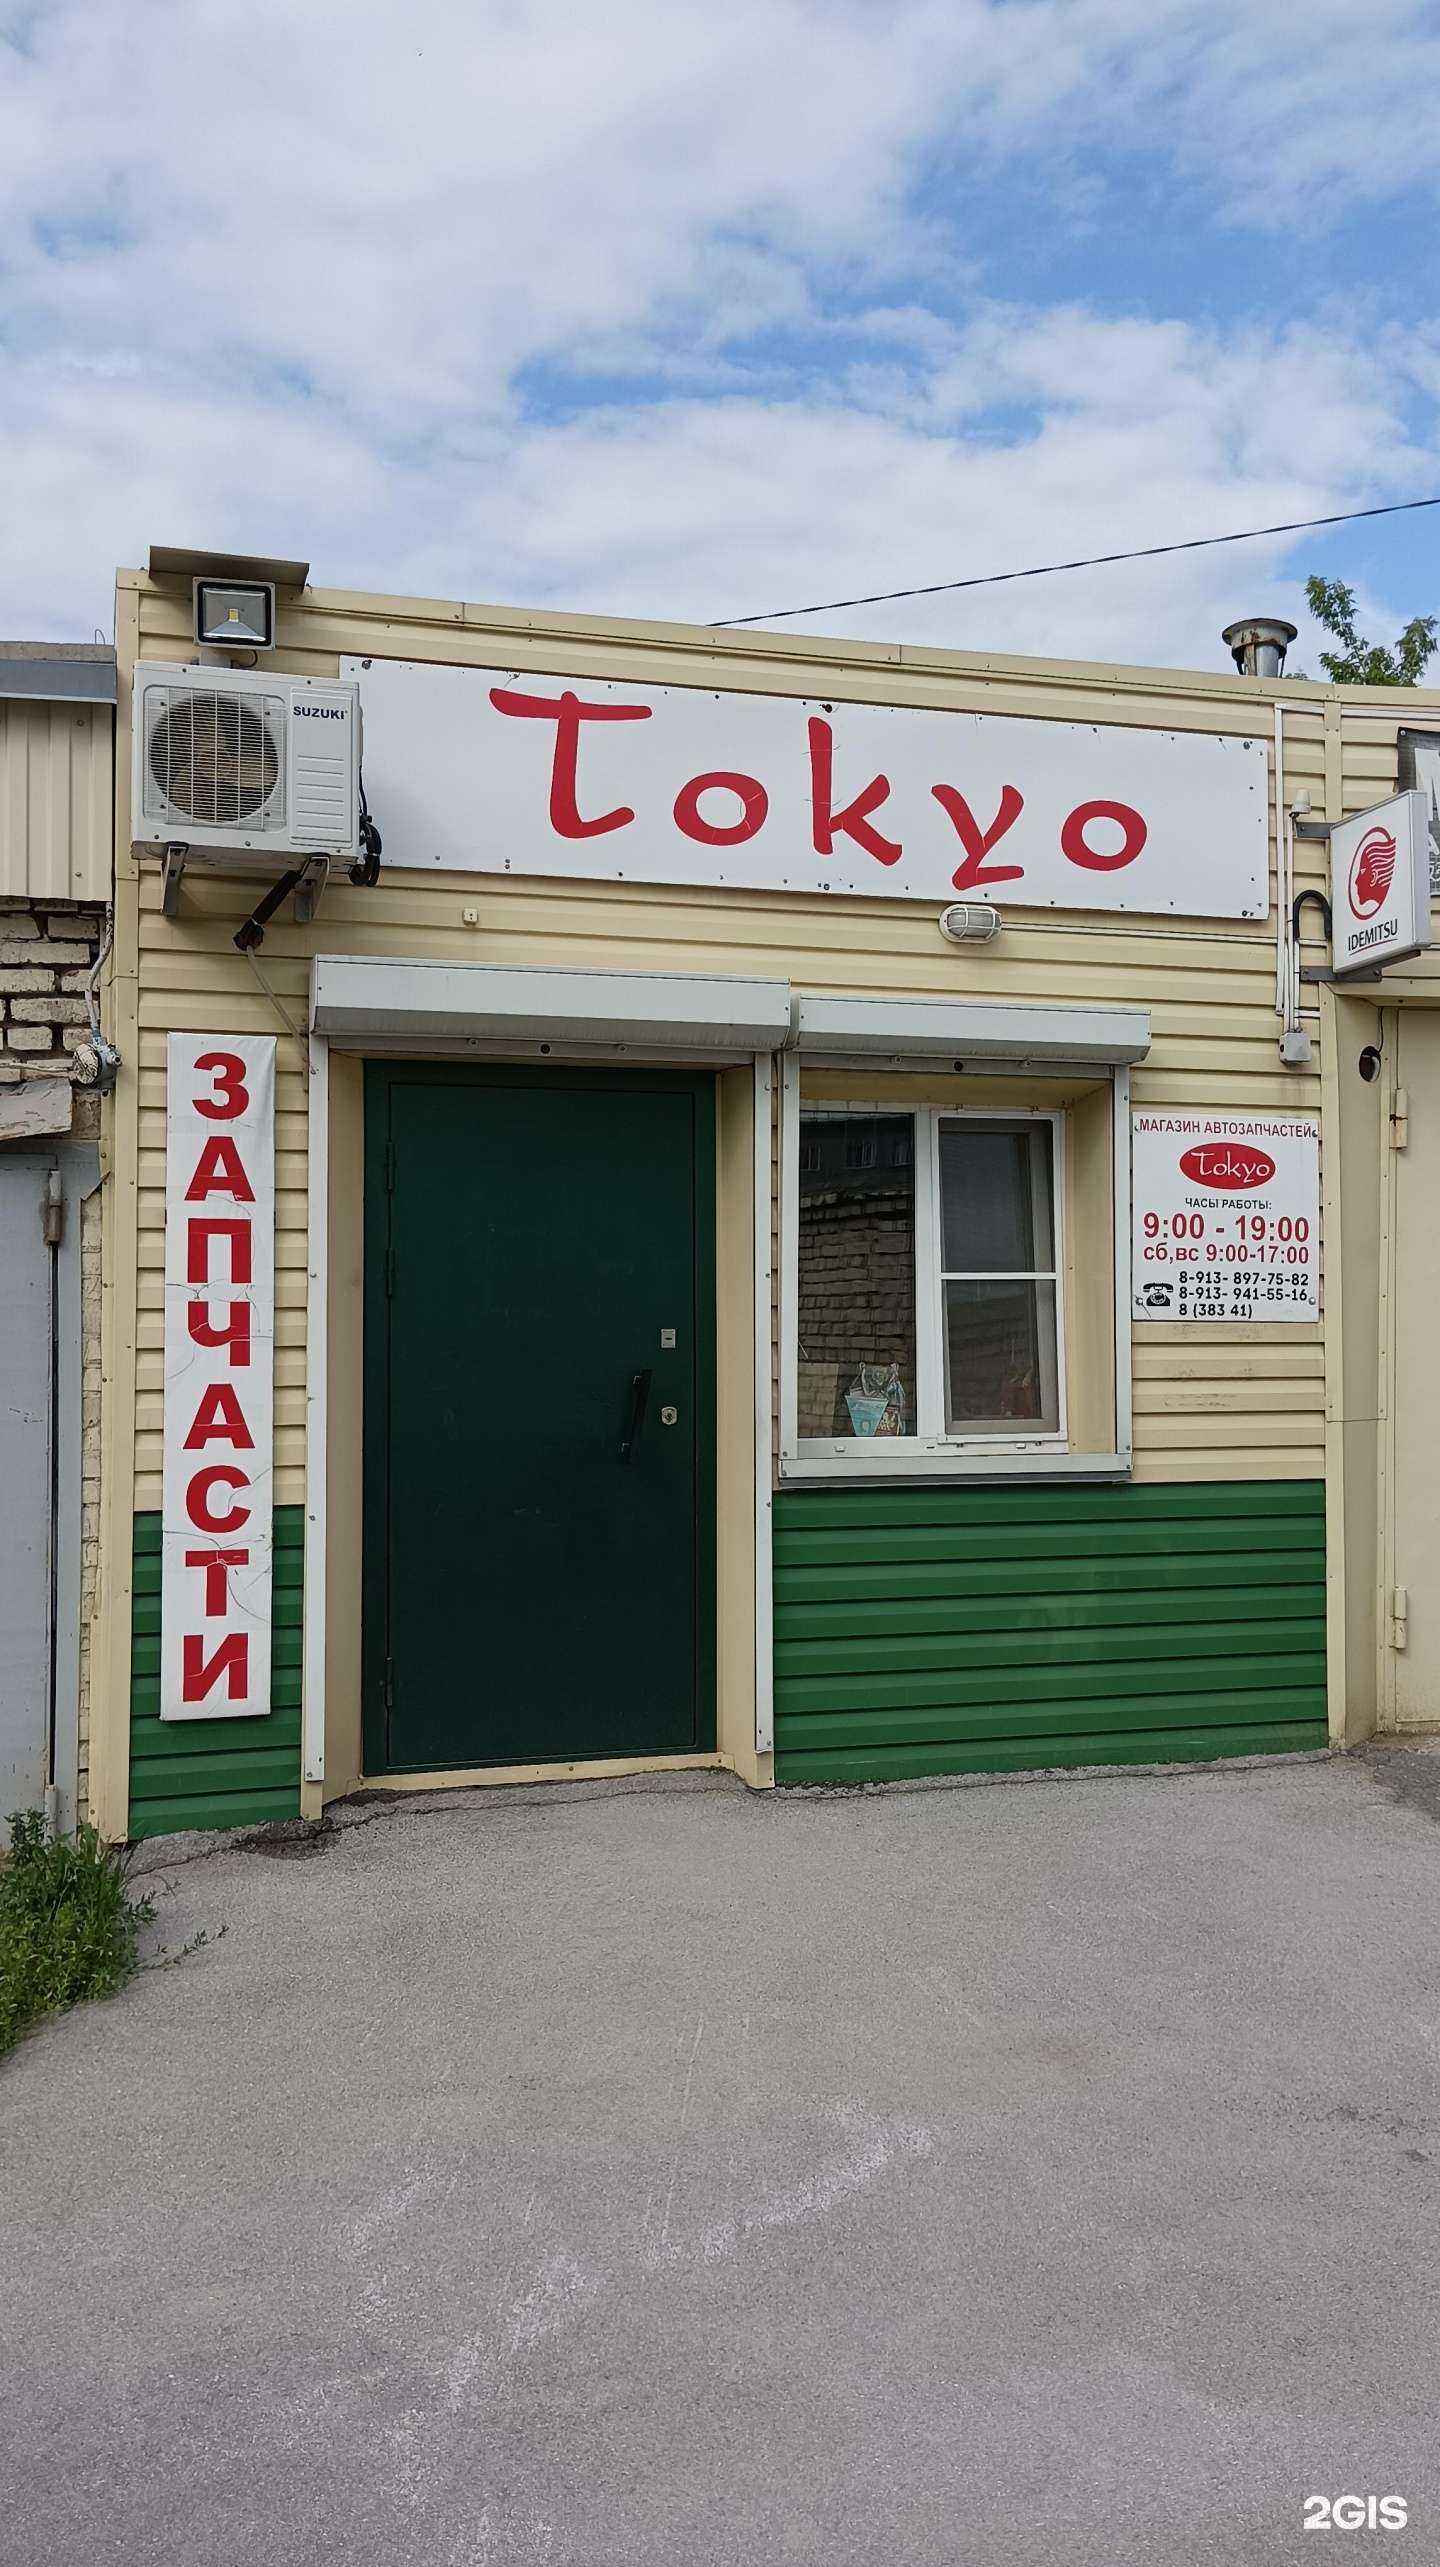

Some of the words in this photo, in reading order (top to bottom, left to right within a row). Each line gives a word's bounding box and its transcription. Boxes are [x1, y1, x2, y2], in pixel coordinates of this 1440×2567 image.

[293, 706, 345, 720] SUZUKI
[490, 691, 1145, 890] Tokyo
[1348, 918, 1398, 950] IDEMITSU
[1139, 1119, 1200, 1133] МАГАЗИН
[1204, 1121, 1311, 1138] АВТОЗАПЧАСТЕЙ
[1191, 1150, 1270, 1183] Tokyo
[1185, 1198, 1219, 1209] ЧАСЫ
[1222, 1200, 1272, 1210] РАБОТЫ:
[1143, 1212, 1205, 1240] 9:00
[1235, 1215, 1310, 1243] 19:00
[1143, 1243, 1199, 1264] сб,вс
[1206, 1244, 1309, 1264] 9:00-17:00
[1233, 1272, 1309, 1286] 897-75-82
[1233, 1287, 1308, 1301] 941-55-16
[1179, 1303, 1188, 1316] 8
[1193, 1303, 1225, 1318] (383
[1230, 1304, 1253, 1318] 41)
[183, 1053, 255, 1702] ЗАПЧАСТИ
